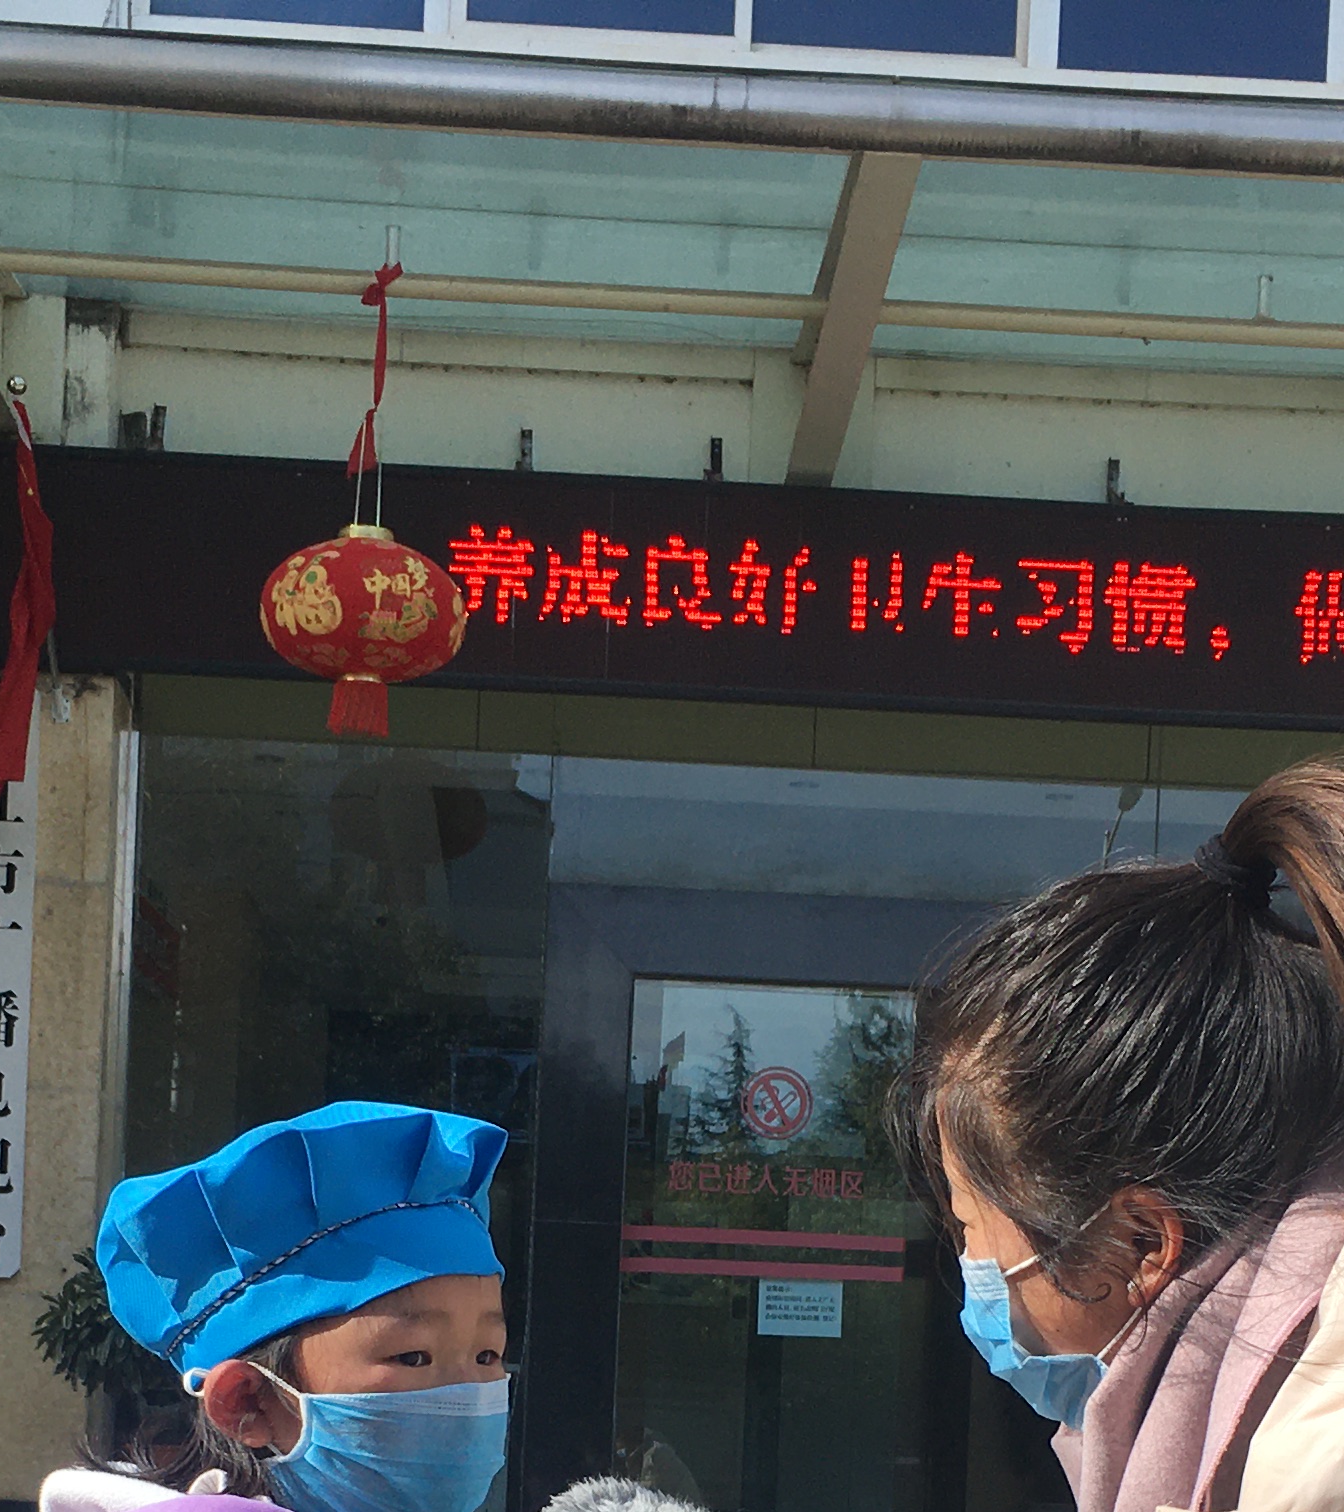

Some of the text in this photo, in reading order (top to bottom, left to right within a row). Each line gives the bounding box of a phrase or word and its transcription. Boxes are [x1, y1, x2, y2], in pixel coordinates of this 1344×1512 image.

[667, 1160, 865, 1200] 您已进入无烟区
